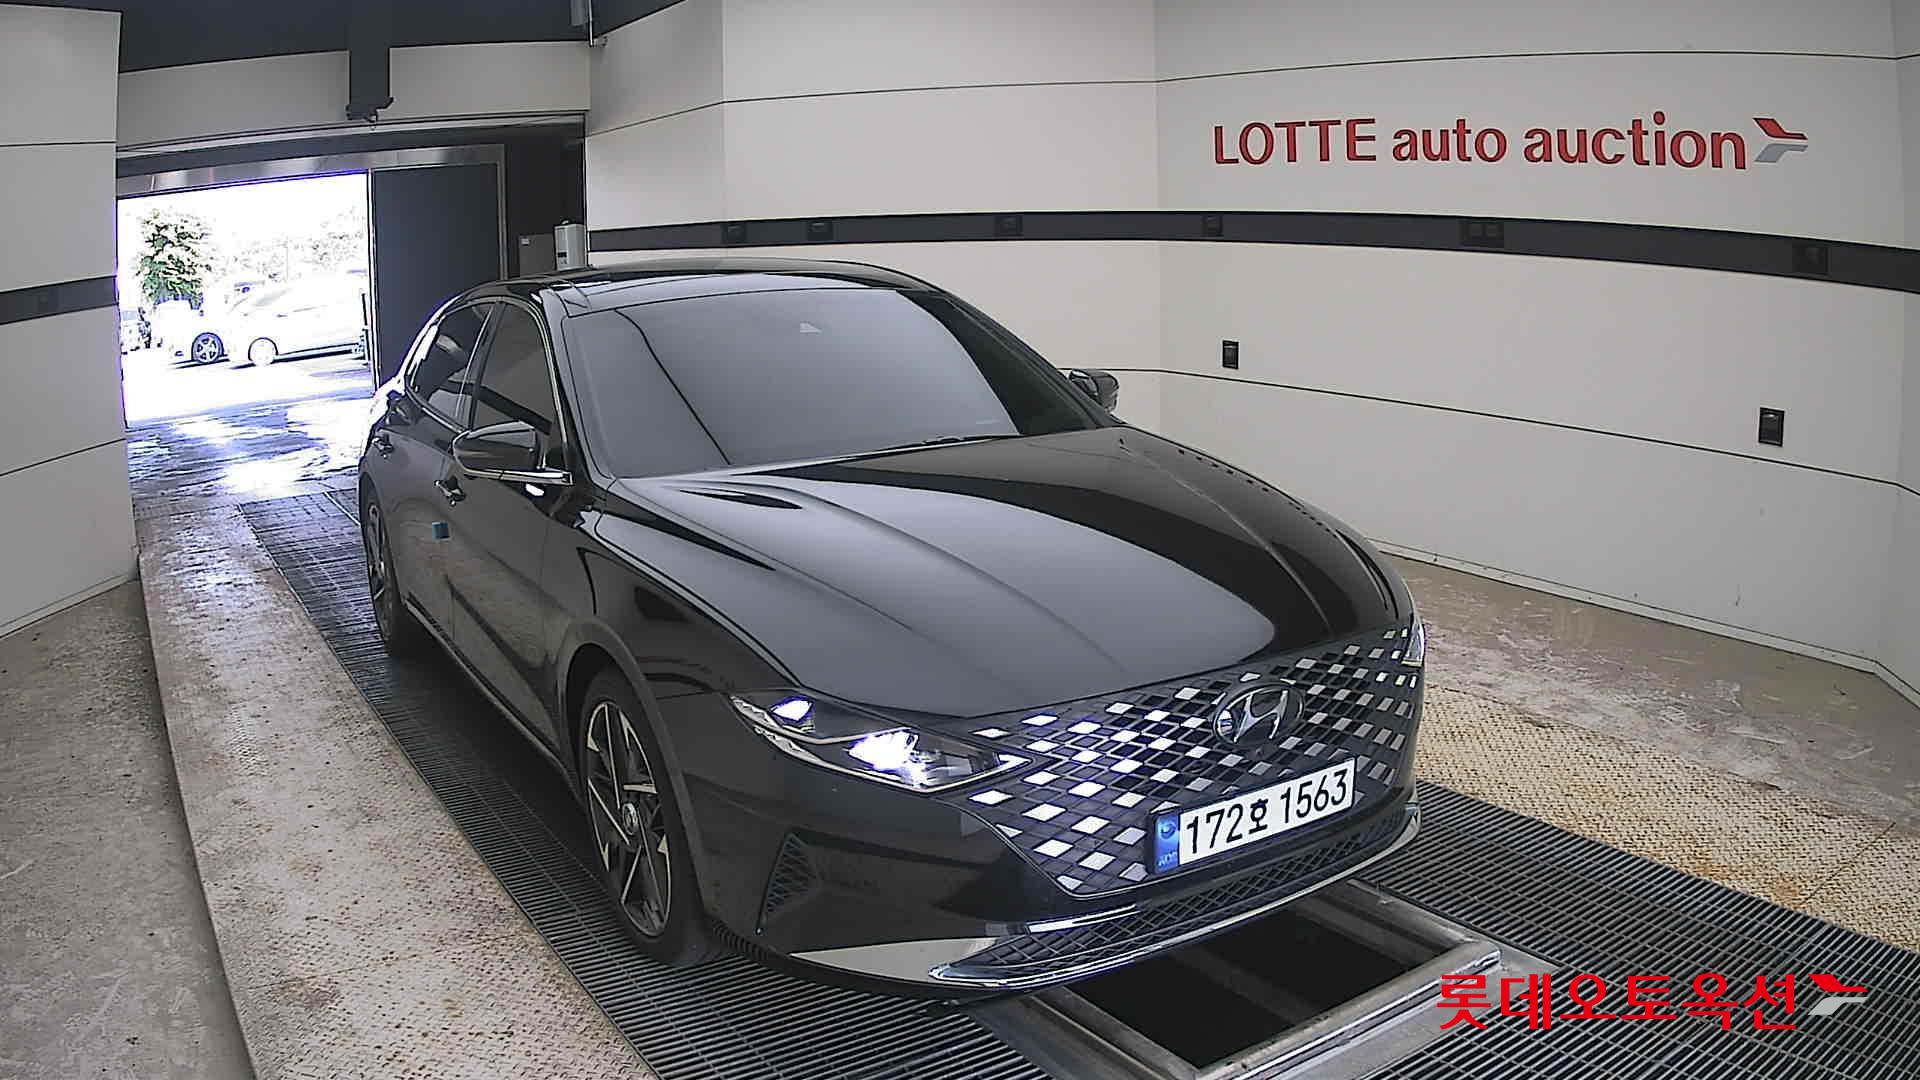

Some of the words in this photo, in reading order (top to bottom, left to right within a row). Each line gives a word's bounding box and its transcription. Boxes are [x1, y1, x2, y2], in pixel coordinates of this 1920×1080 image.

[1214, 117, 1376, 164] LOTTE
[1392, 118, 1507, 163] auto
[1523, 111, 1746, 170] auction
[1186, 798, 1269, 854] 172호
[1280, 768, 1348, 824] 1563
